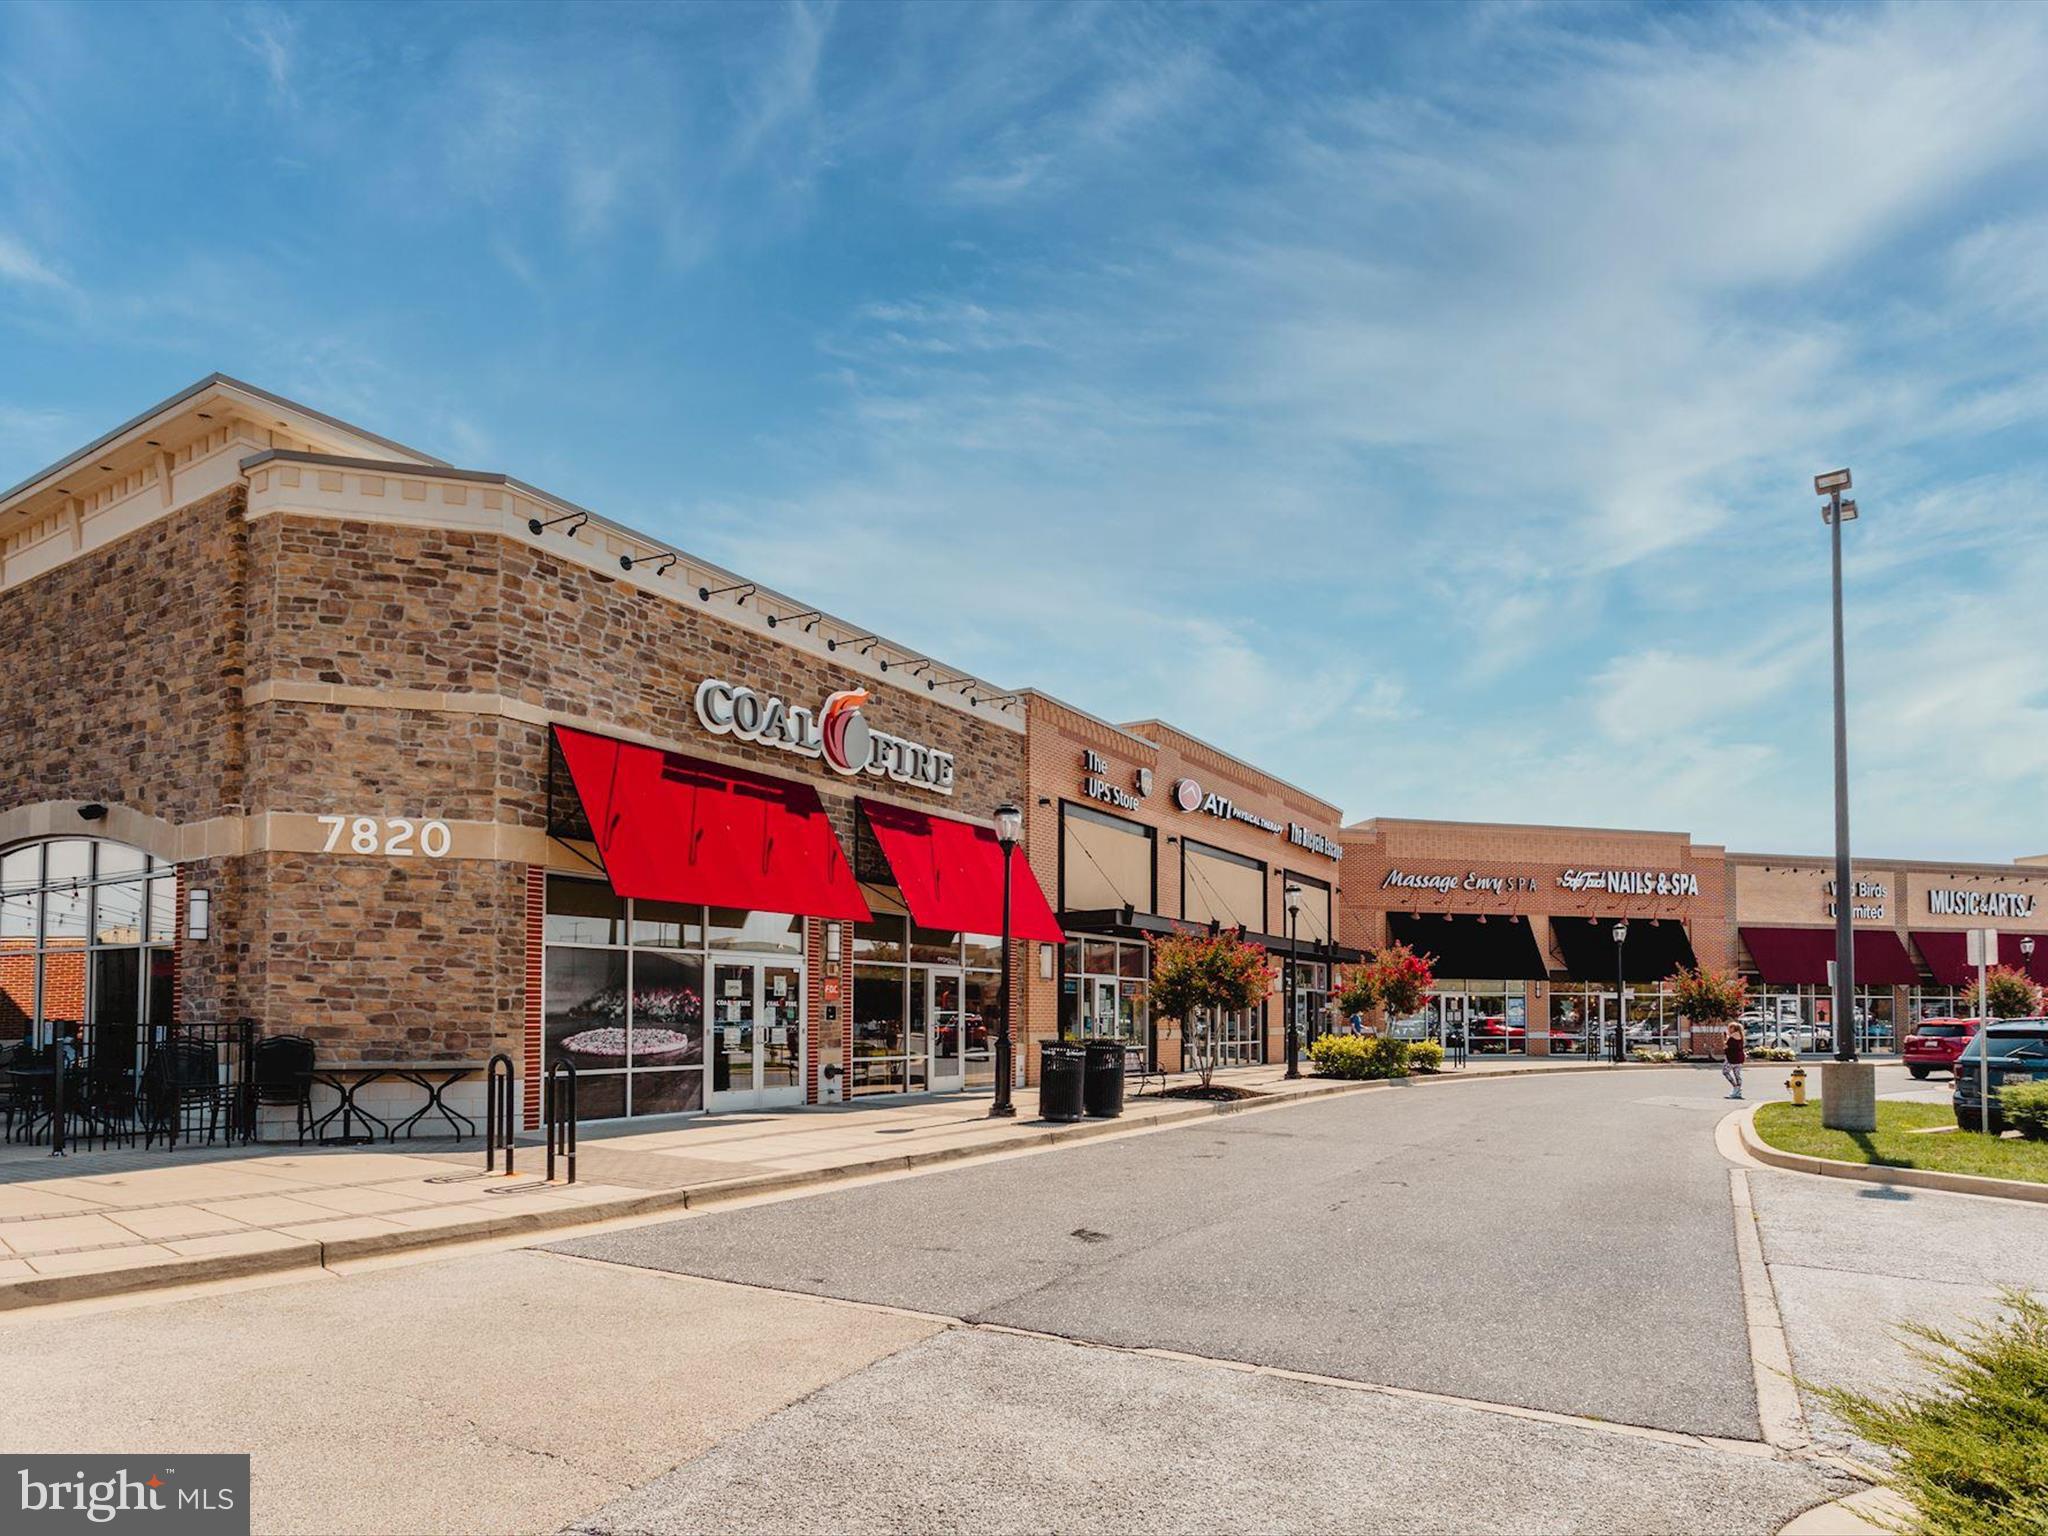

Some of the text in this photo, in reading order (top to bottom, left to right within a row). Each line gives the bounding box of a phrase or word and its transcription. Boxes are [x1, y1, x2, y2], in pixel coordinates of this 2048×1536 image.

[697, 679, 953, 792] COAL FIRE
[1088, 750, 1107, 774] The
[1089, 778, 1110, 802] UPS
[1113, 786, 1139, 810] Store
[1205, 793, 1232, 819] ATI
[318, 816, 452, 858] 7820
[1383, 869, 1537, 894] Massage Envy SPA
[1608, 871, 1652, 894] NAILS
[1657, 873, 1668, 895] &
[1671, 873, 1699, 896] SPA
[1860, 883, 1888, 898] Birds
[1830, 903, 1885, 919] Umited
